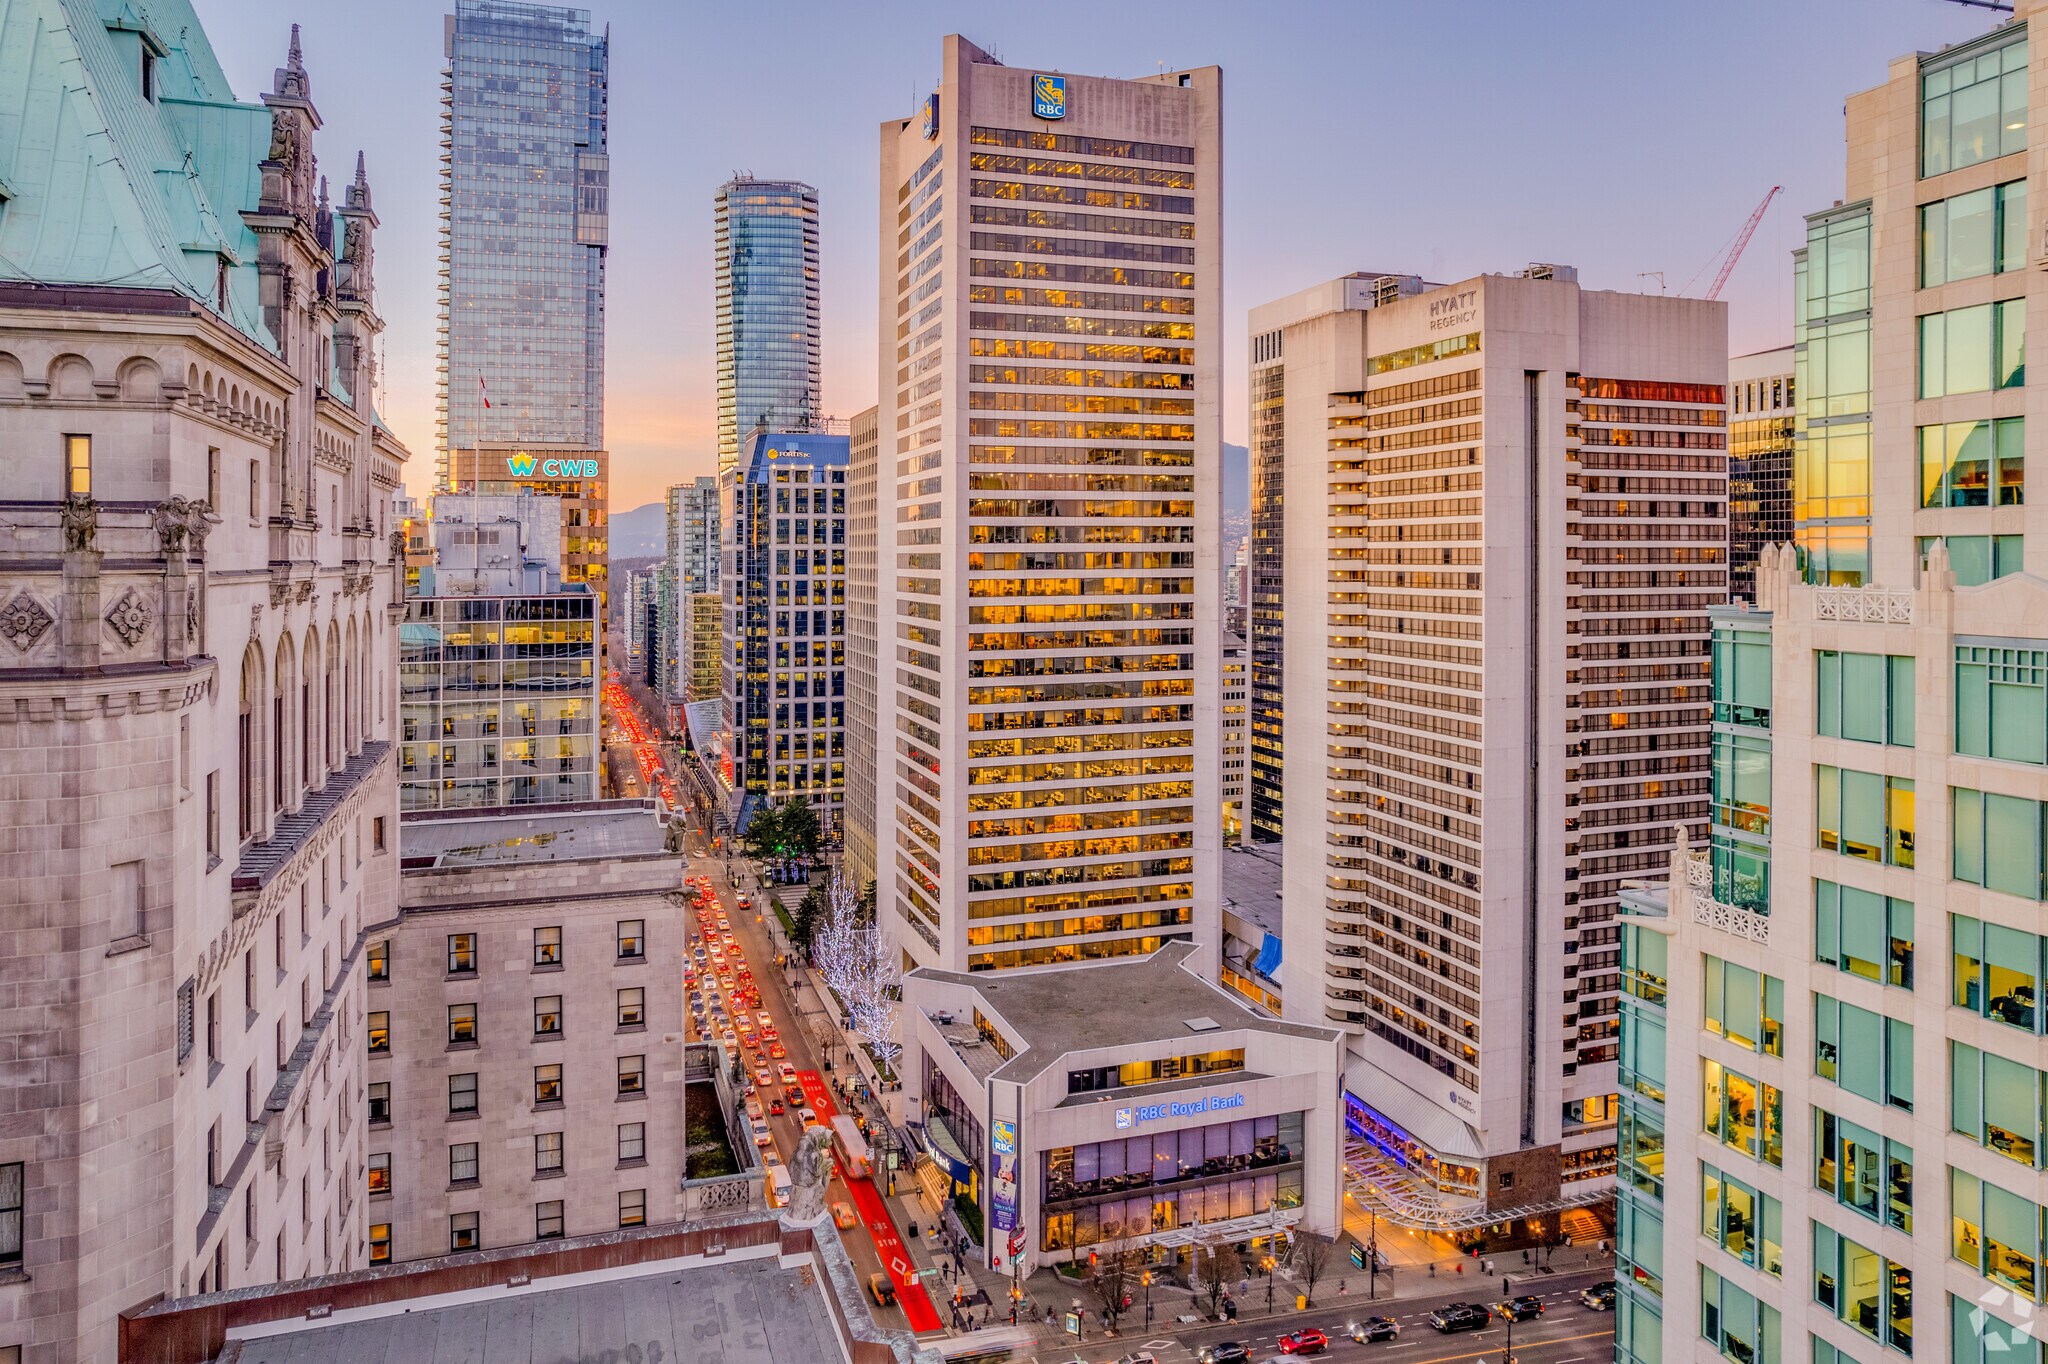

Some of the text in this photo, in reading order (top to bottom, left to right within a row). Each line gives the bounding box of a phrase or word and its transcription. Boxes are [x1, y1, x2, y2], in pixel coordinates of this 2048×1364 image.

[1038, 103, 1063, 115] RBC
[1430, 290, 1477, 317] HYATT
[1430, 309, 1476, 330] REGENCY
[543, 459, 598, 477] CWB
[1140, 1092, 1245, 1120] RBC Royal Bank
[994, 1142, 1013, 1152] RBC
[935, 1149, 951, 1172] Bank
[878, 1238, 897, 1247] STOP
